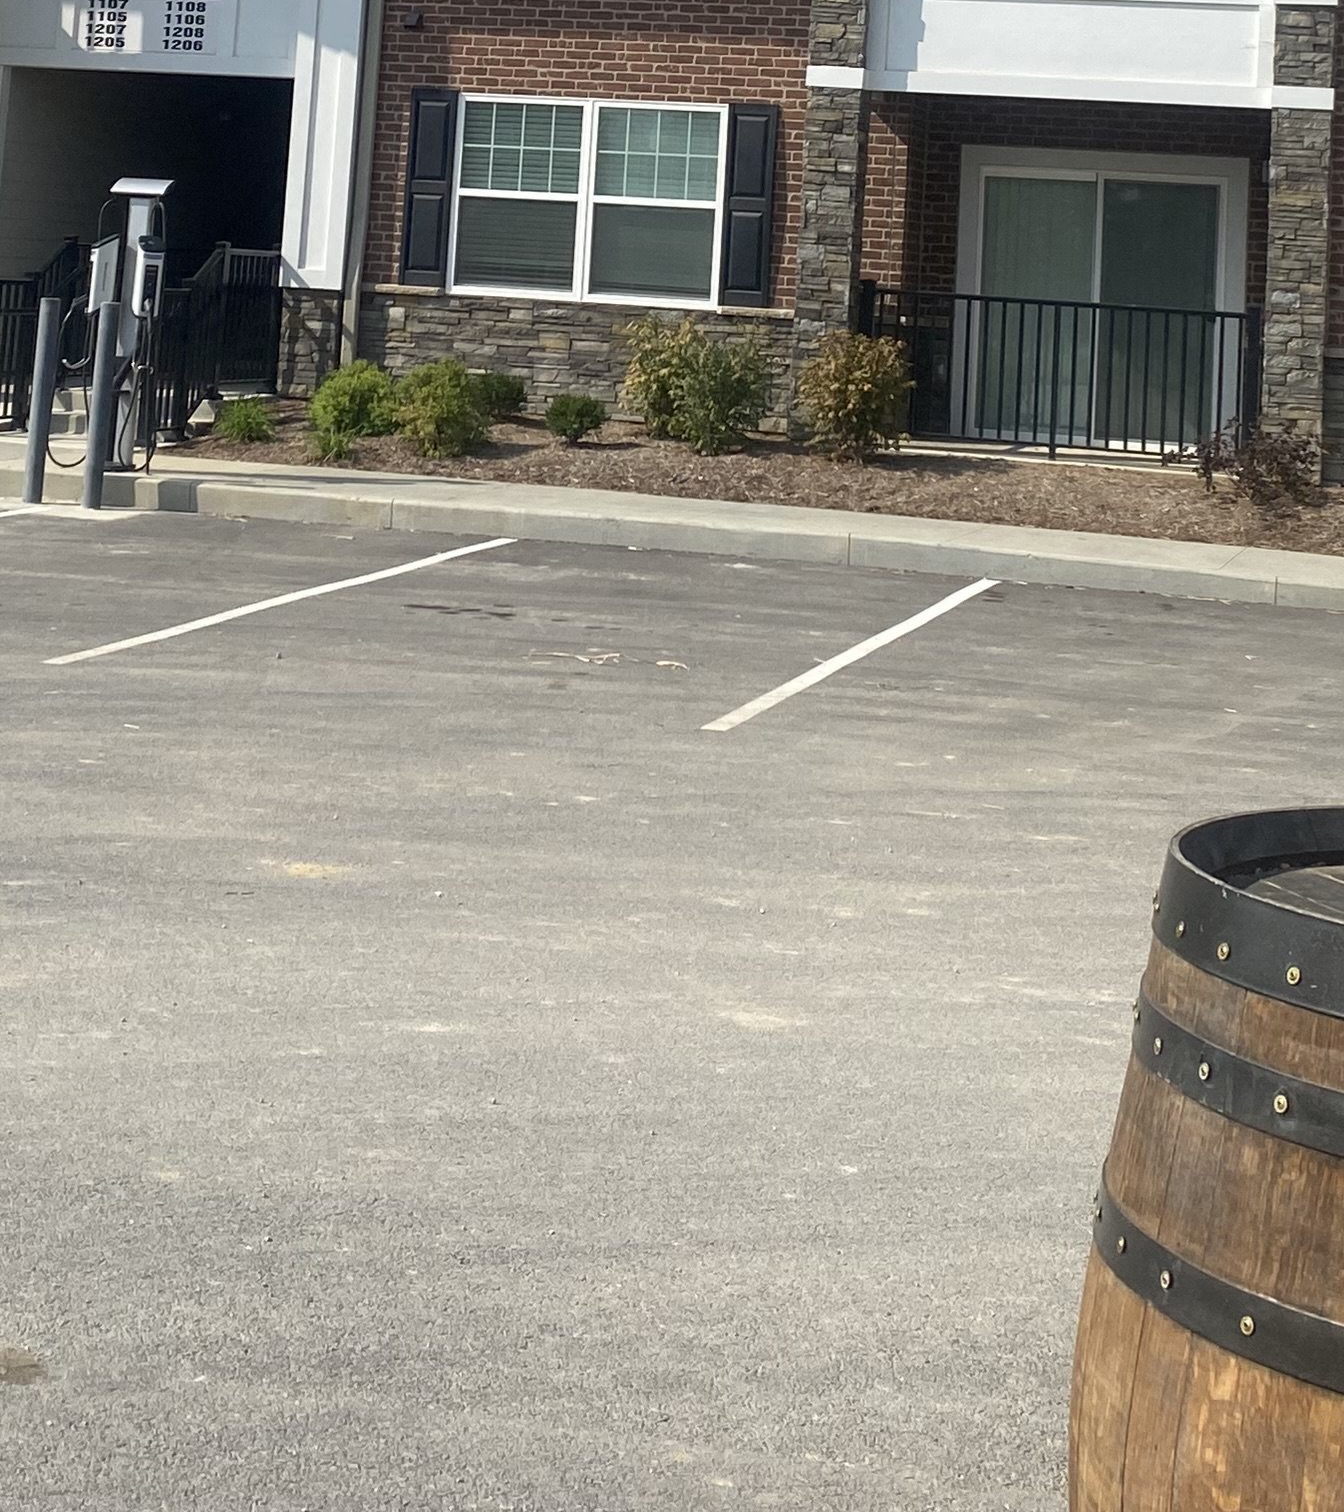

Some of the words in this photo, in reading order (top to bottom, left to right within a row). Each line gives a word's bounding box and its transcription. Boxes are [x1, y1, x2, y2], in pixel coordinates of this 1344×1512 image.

[165, 1, 206, 12] 1108
[87, 11, 127, 22] 1105
[164, 13, 205, 25] 1106
[86, 23, 127, 35] 1207
[163, 26, 204, 38] 1208
[85, 36, 125, 48] 1205
[162, 39, 203, 51] 1206
